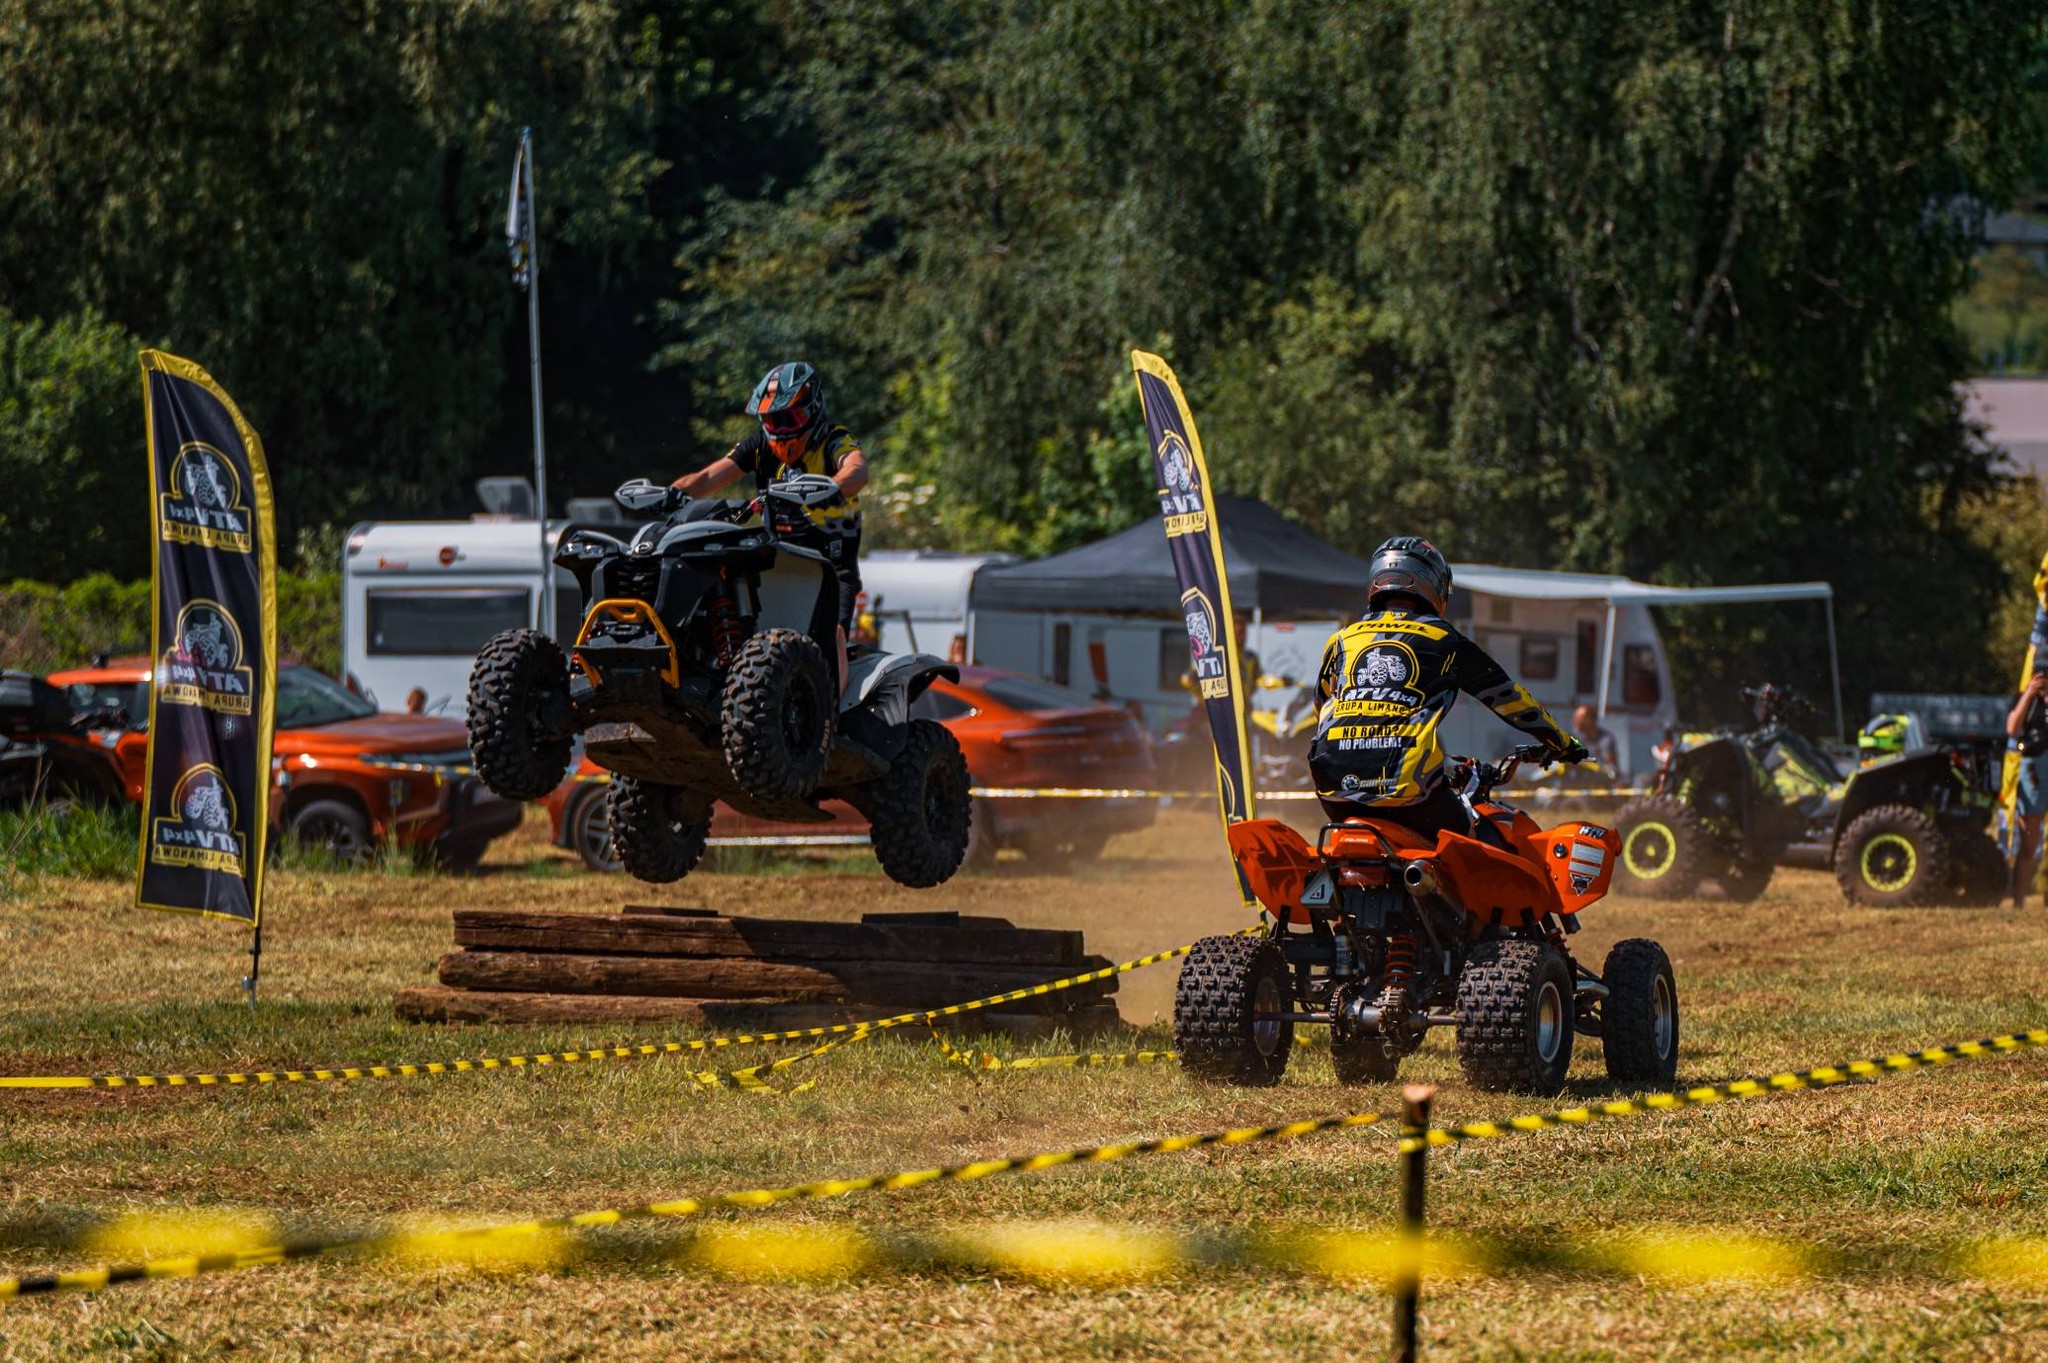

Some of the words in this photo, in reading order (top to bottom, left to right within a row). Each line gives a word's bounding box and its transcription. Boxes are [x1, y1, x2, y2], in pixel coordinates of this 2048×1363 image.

[1344, 687, 1392, 701] ATV
[1389, 690, 1417, 706] 4x4
[1336, 701, 1363, 713] GRUPA
[1342, 726, 1357, 738] NO
[1360, 725, 1399, 738] ROAD?
[1338, 738, 1352, 750] NO
[1352, 736, 1402, 749] PROBLEM!
